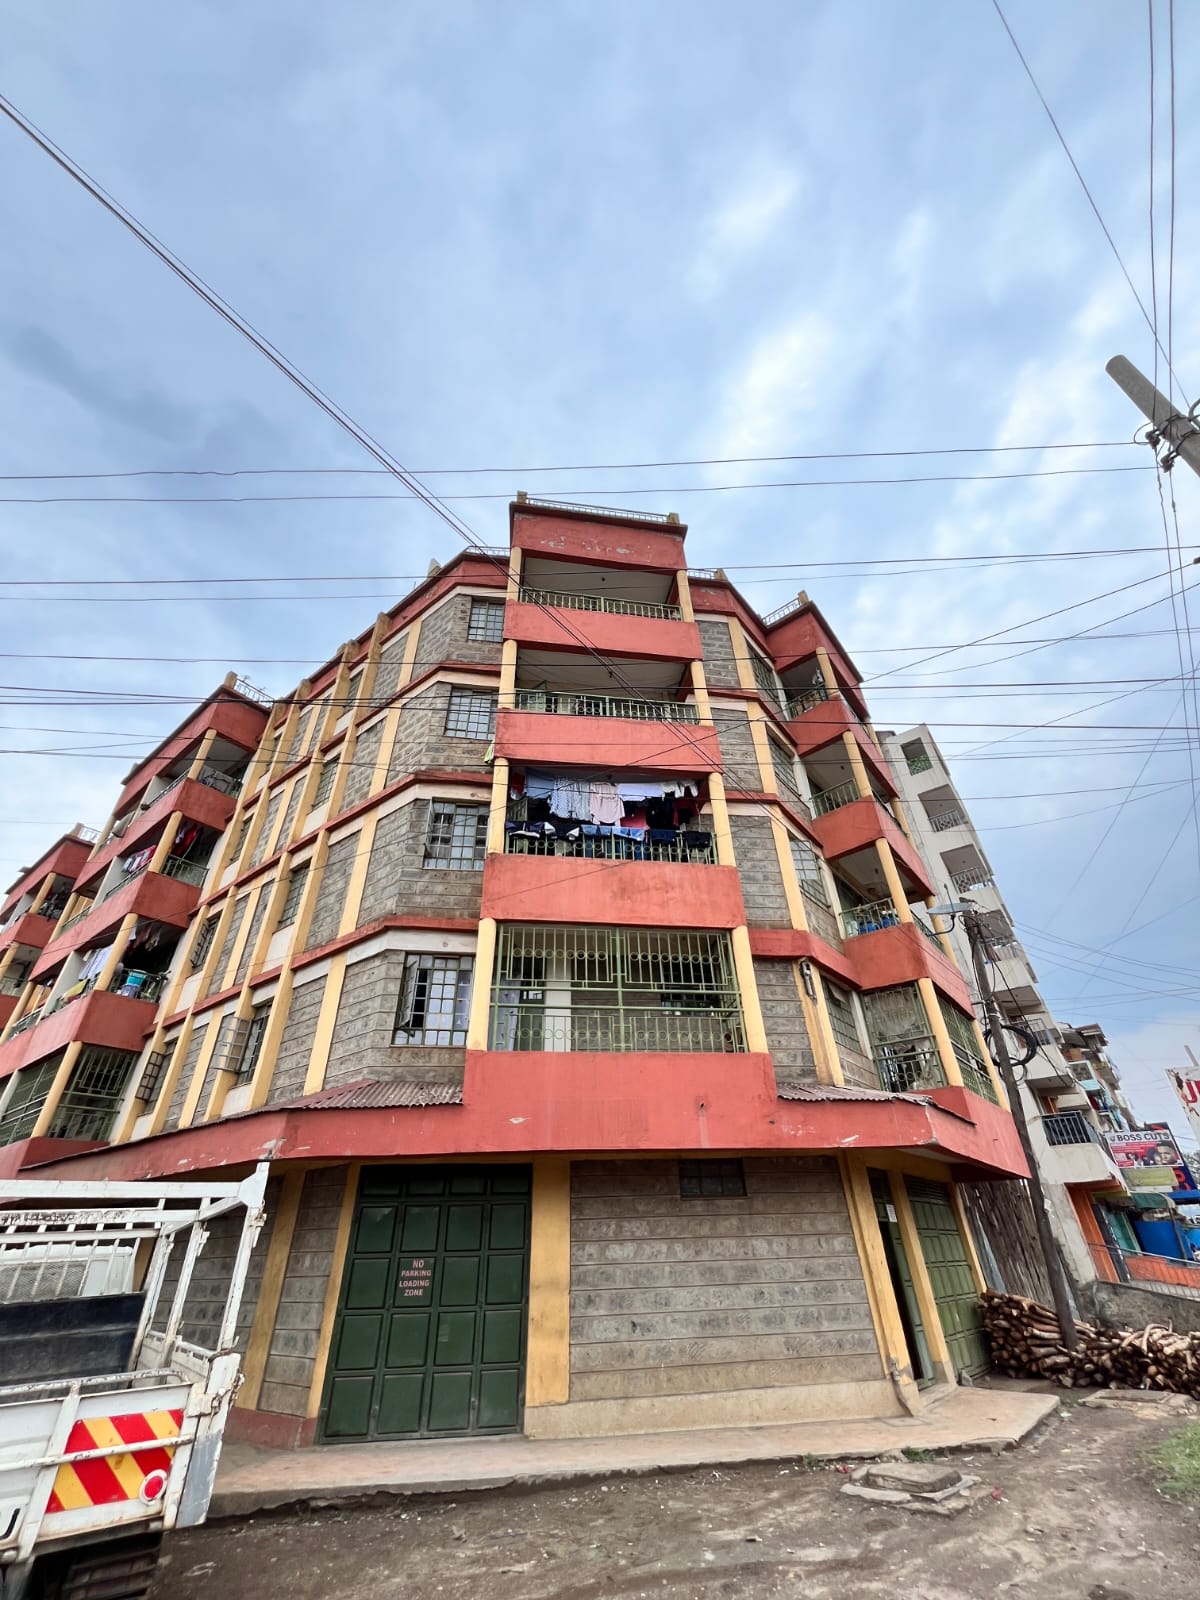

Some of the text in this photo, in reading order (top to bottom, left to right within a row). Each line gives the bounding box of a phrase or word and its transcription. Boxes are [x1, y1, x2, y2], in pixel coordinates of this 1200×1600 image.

[1116, 1132, 1170, 1142] BOSS CUTS
[413, 1259, 424, 1268] NO
[399, 1279, 430, 1287] LOADING
